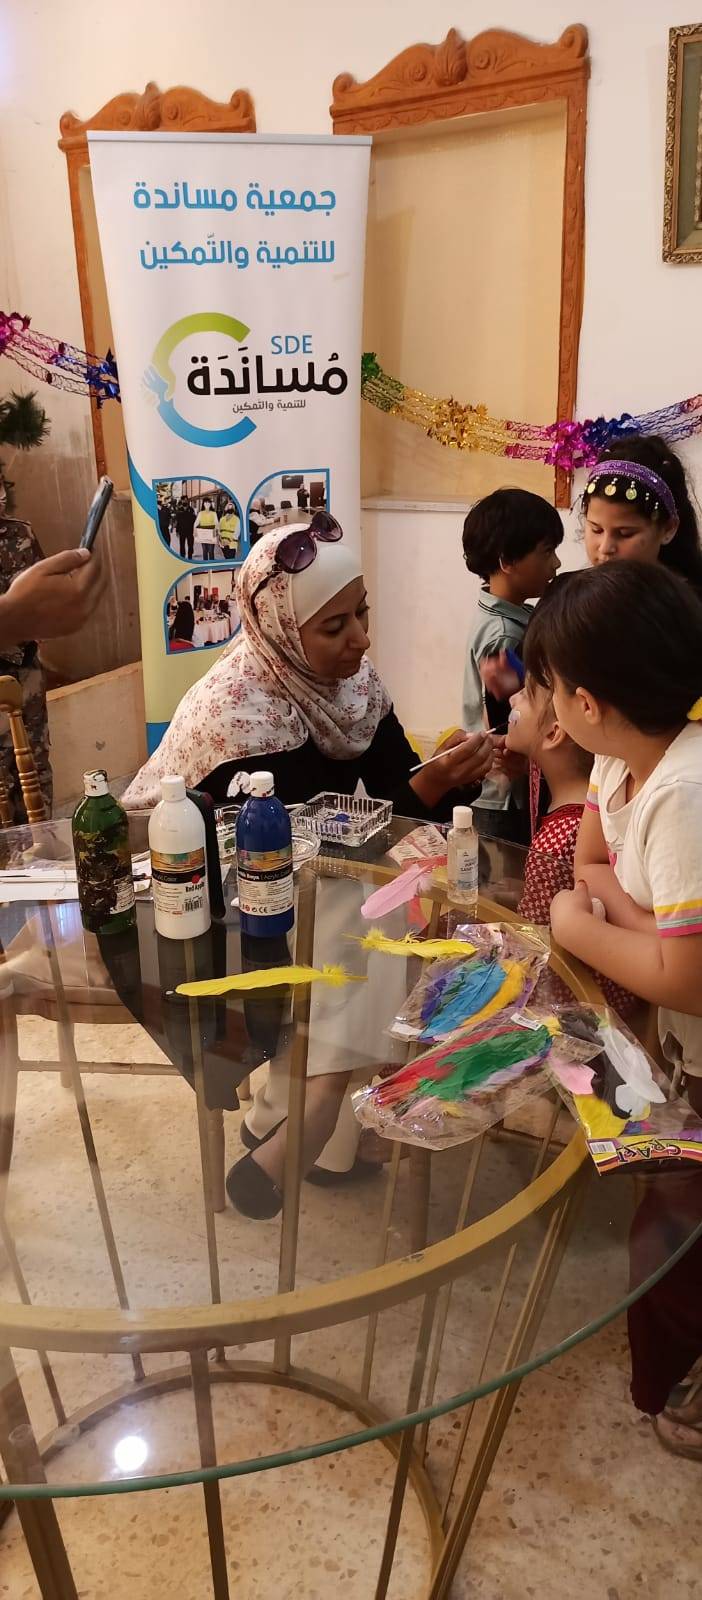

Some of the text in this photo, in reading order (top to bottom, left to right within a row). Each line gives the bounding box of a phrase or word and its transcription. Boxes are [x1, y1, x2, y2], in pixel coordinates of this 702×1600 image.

[133, 182, 337, 216] جمعية مساندة
[256, 240, 336, 269] للتنمية
[270, 335, 313, 355] SDE
[232, 399, 306, 414] للتنمية والتمكين
[618, 1139, 682, 1163] CRAFT
